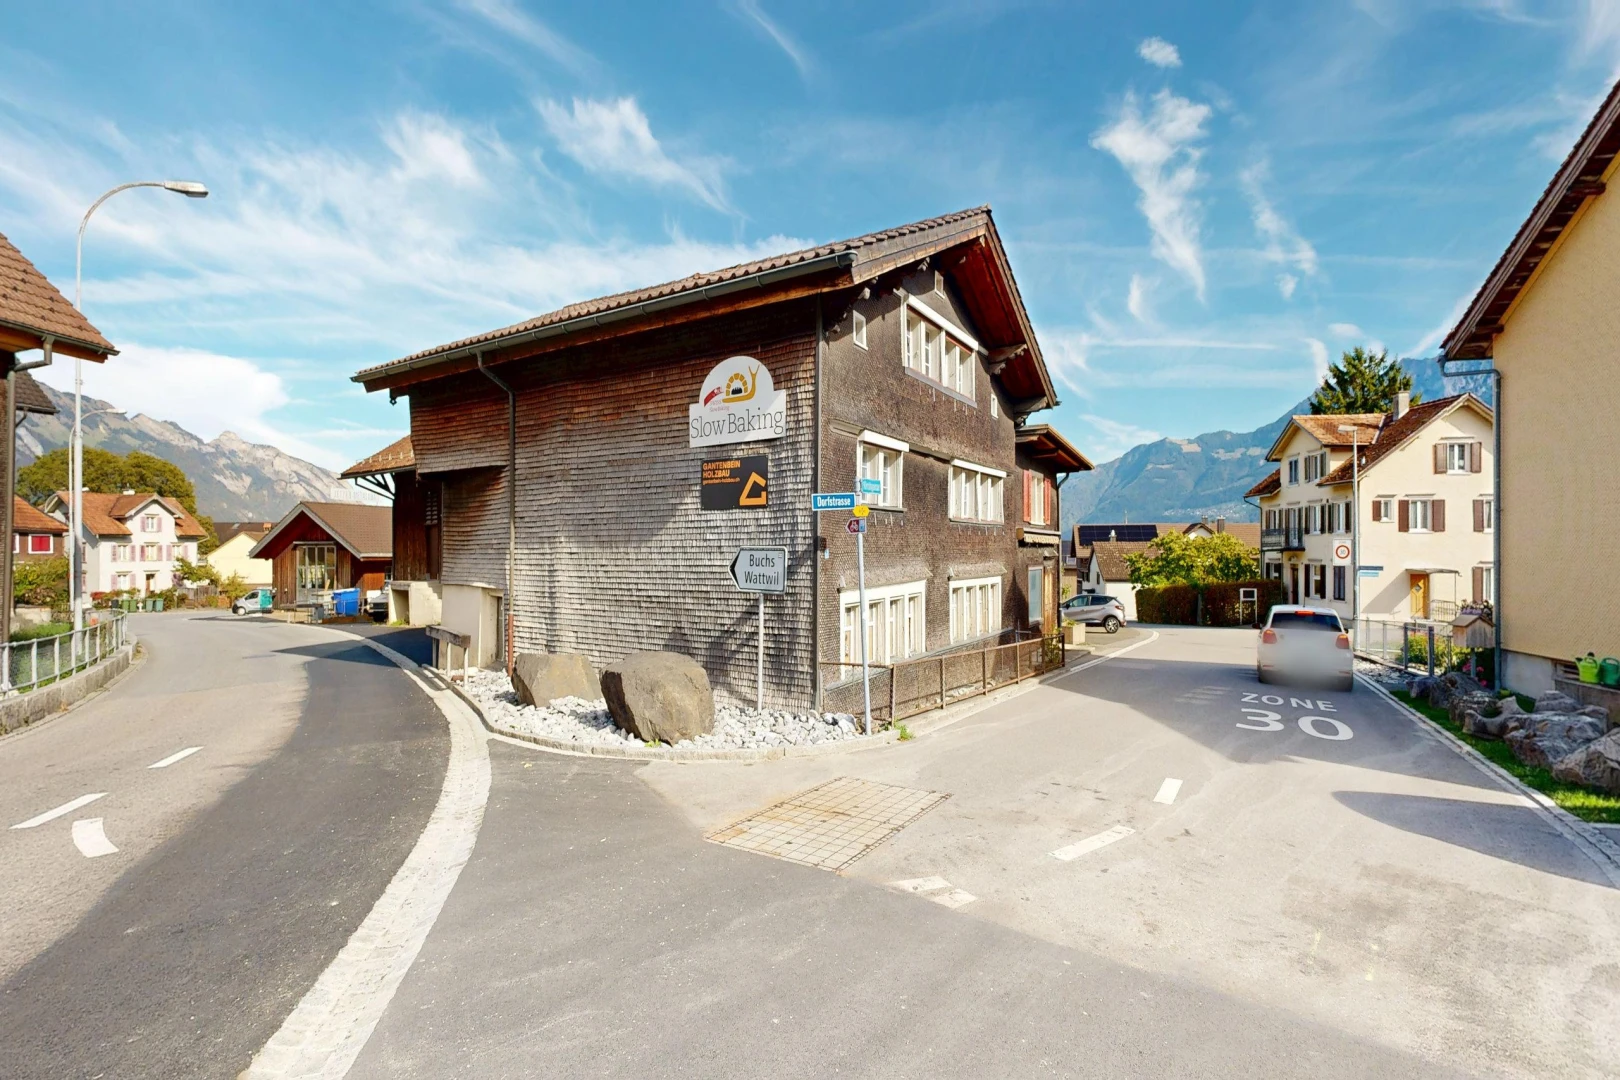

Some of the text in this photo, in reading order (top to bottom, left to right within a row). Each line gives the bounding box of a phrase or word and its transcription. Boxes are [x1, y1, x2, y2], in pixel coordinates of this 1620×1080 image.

[702, 460, 741, 470] GANTENBEIN
[703, 469, 730, 478] HOLZBAU
[817, 496, 851, 507] Dorfstrasse
[749, 553, 775, 568] Buchs
[744, 570, 779, 585] Wattwil
[1240, 692, 1338, 712] ZONE
[1235, 708, 1354, 741] 30
